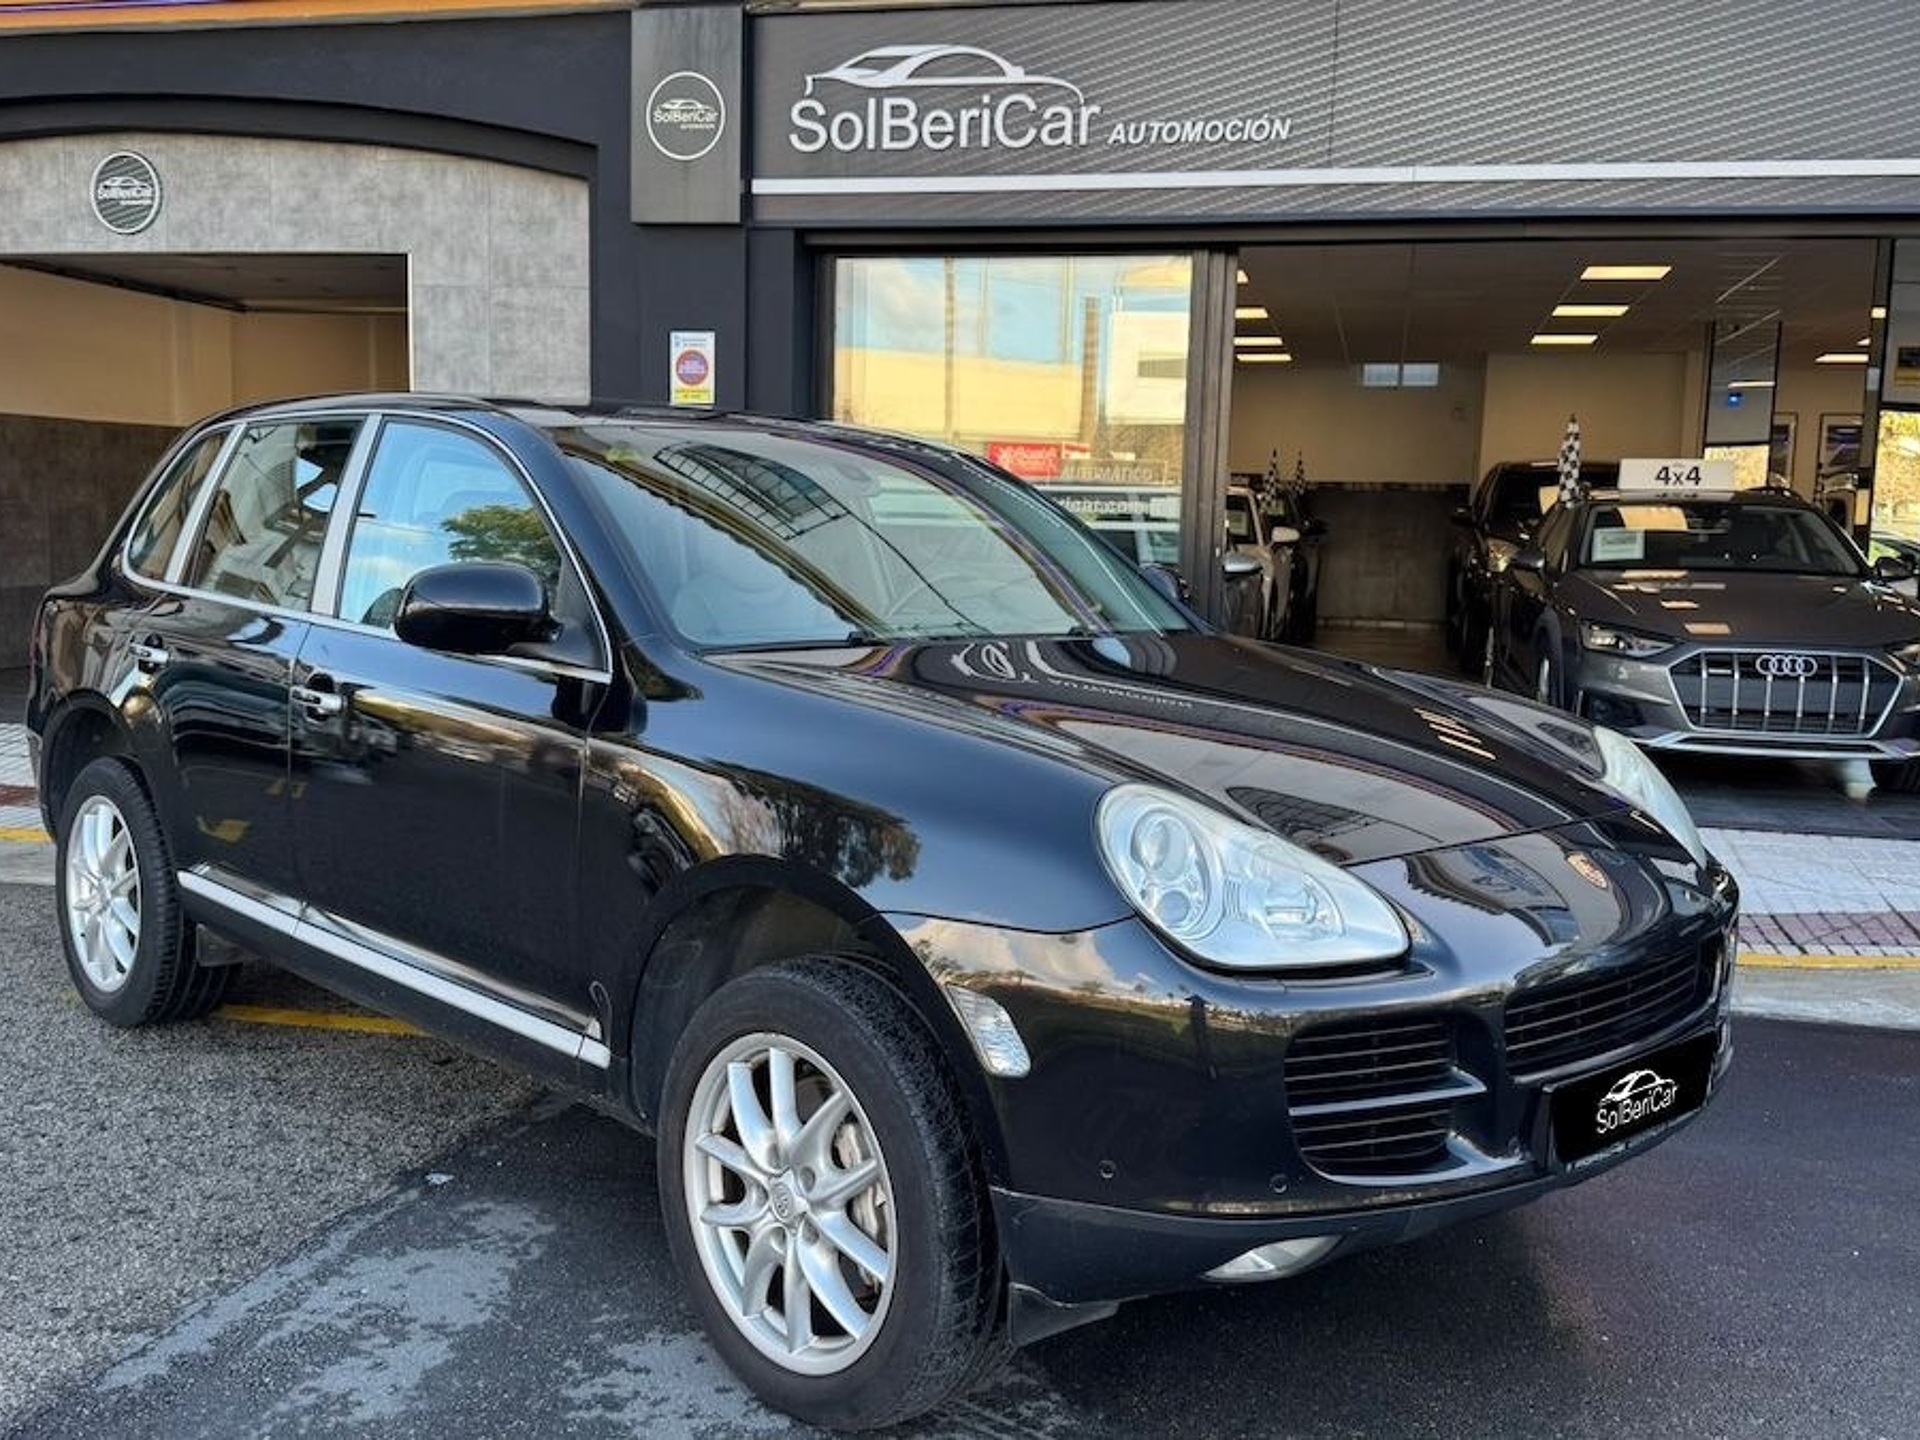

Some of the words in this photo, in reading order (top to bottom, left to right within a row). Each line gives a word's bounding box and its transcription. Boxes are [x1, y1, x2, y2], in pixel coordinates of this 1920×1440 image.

[789, 93, 1101, 152] SolBeriCar
[1107, 113, 1292, 145] AUTOMOCIÓN
[1654, 465, 1702, 486] 4x4
